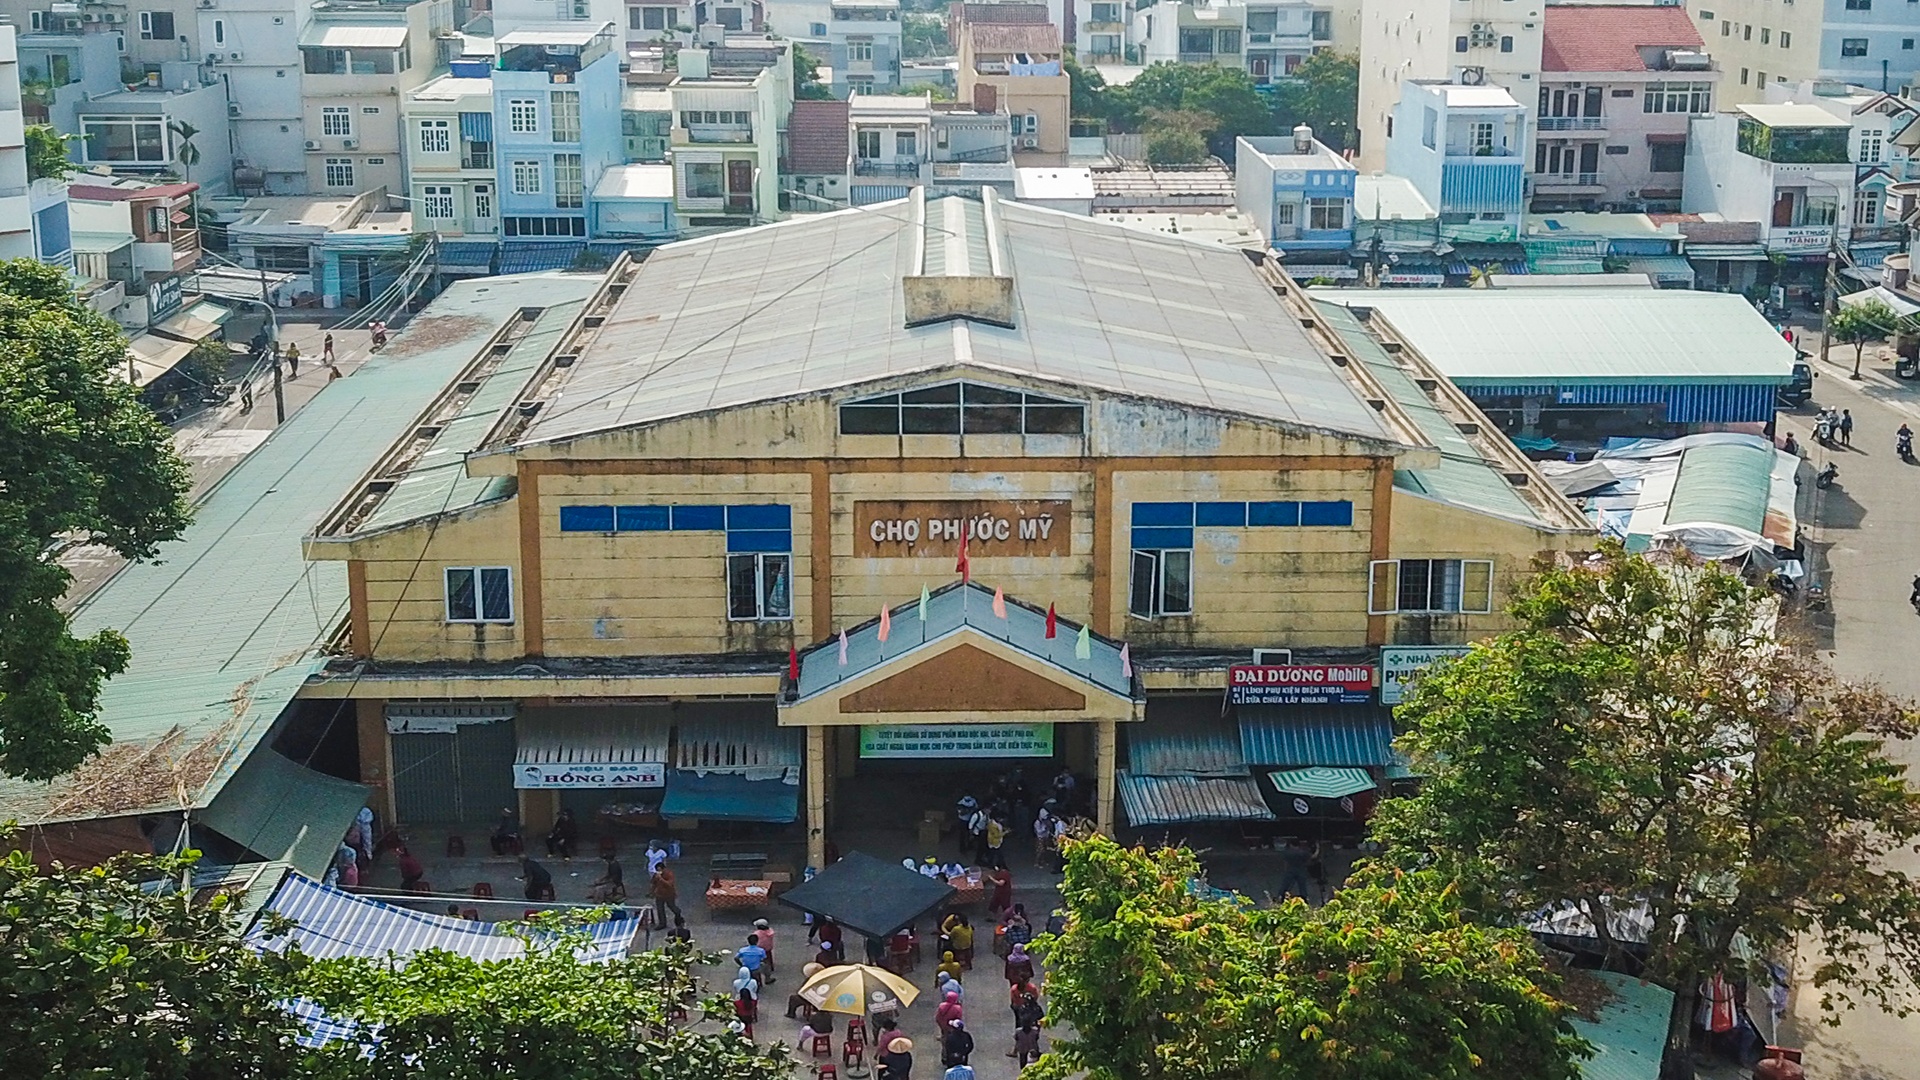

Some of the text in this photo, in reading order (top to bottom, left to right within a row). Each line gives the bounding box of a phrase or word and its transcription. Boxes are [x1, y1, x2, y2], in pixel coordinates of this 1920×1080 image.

[870, 512, 1053, 547] CHỢ PHƯỚC MỸ
[1235, 668, 1369, 685] ĐẠI DƯƠNG Mobile
[544, 771, 657, 783] HỒNG ANH
